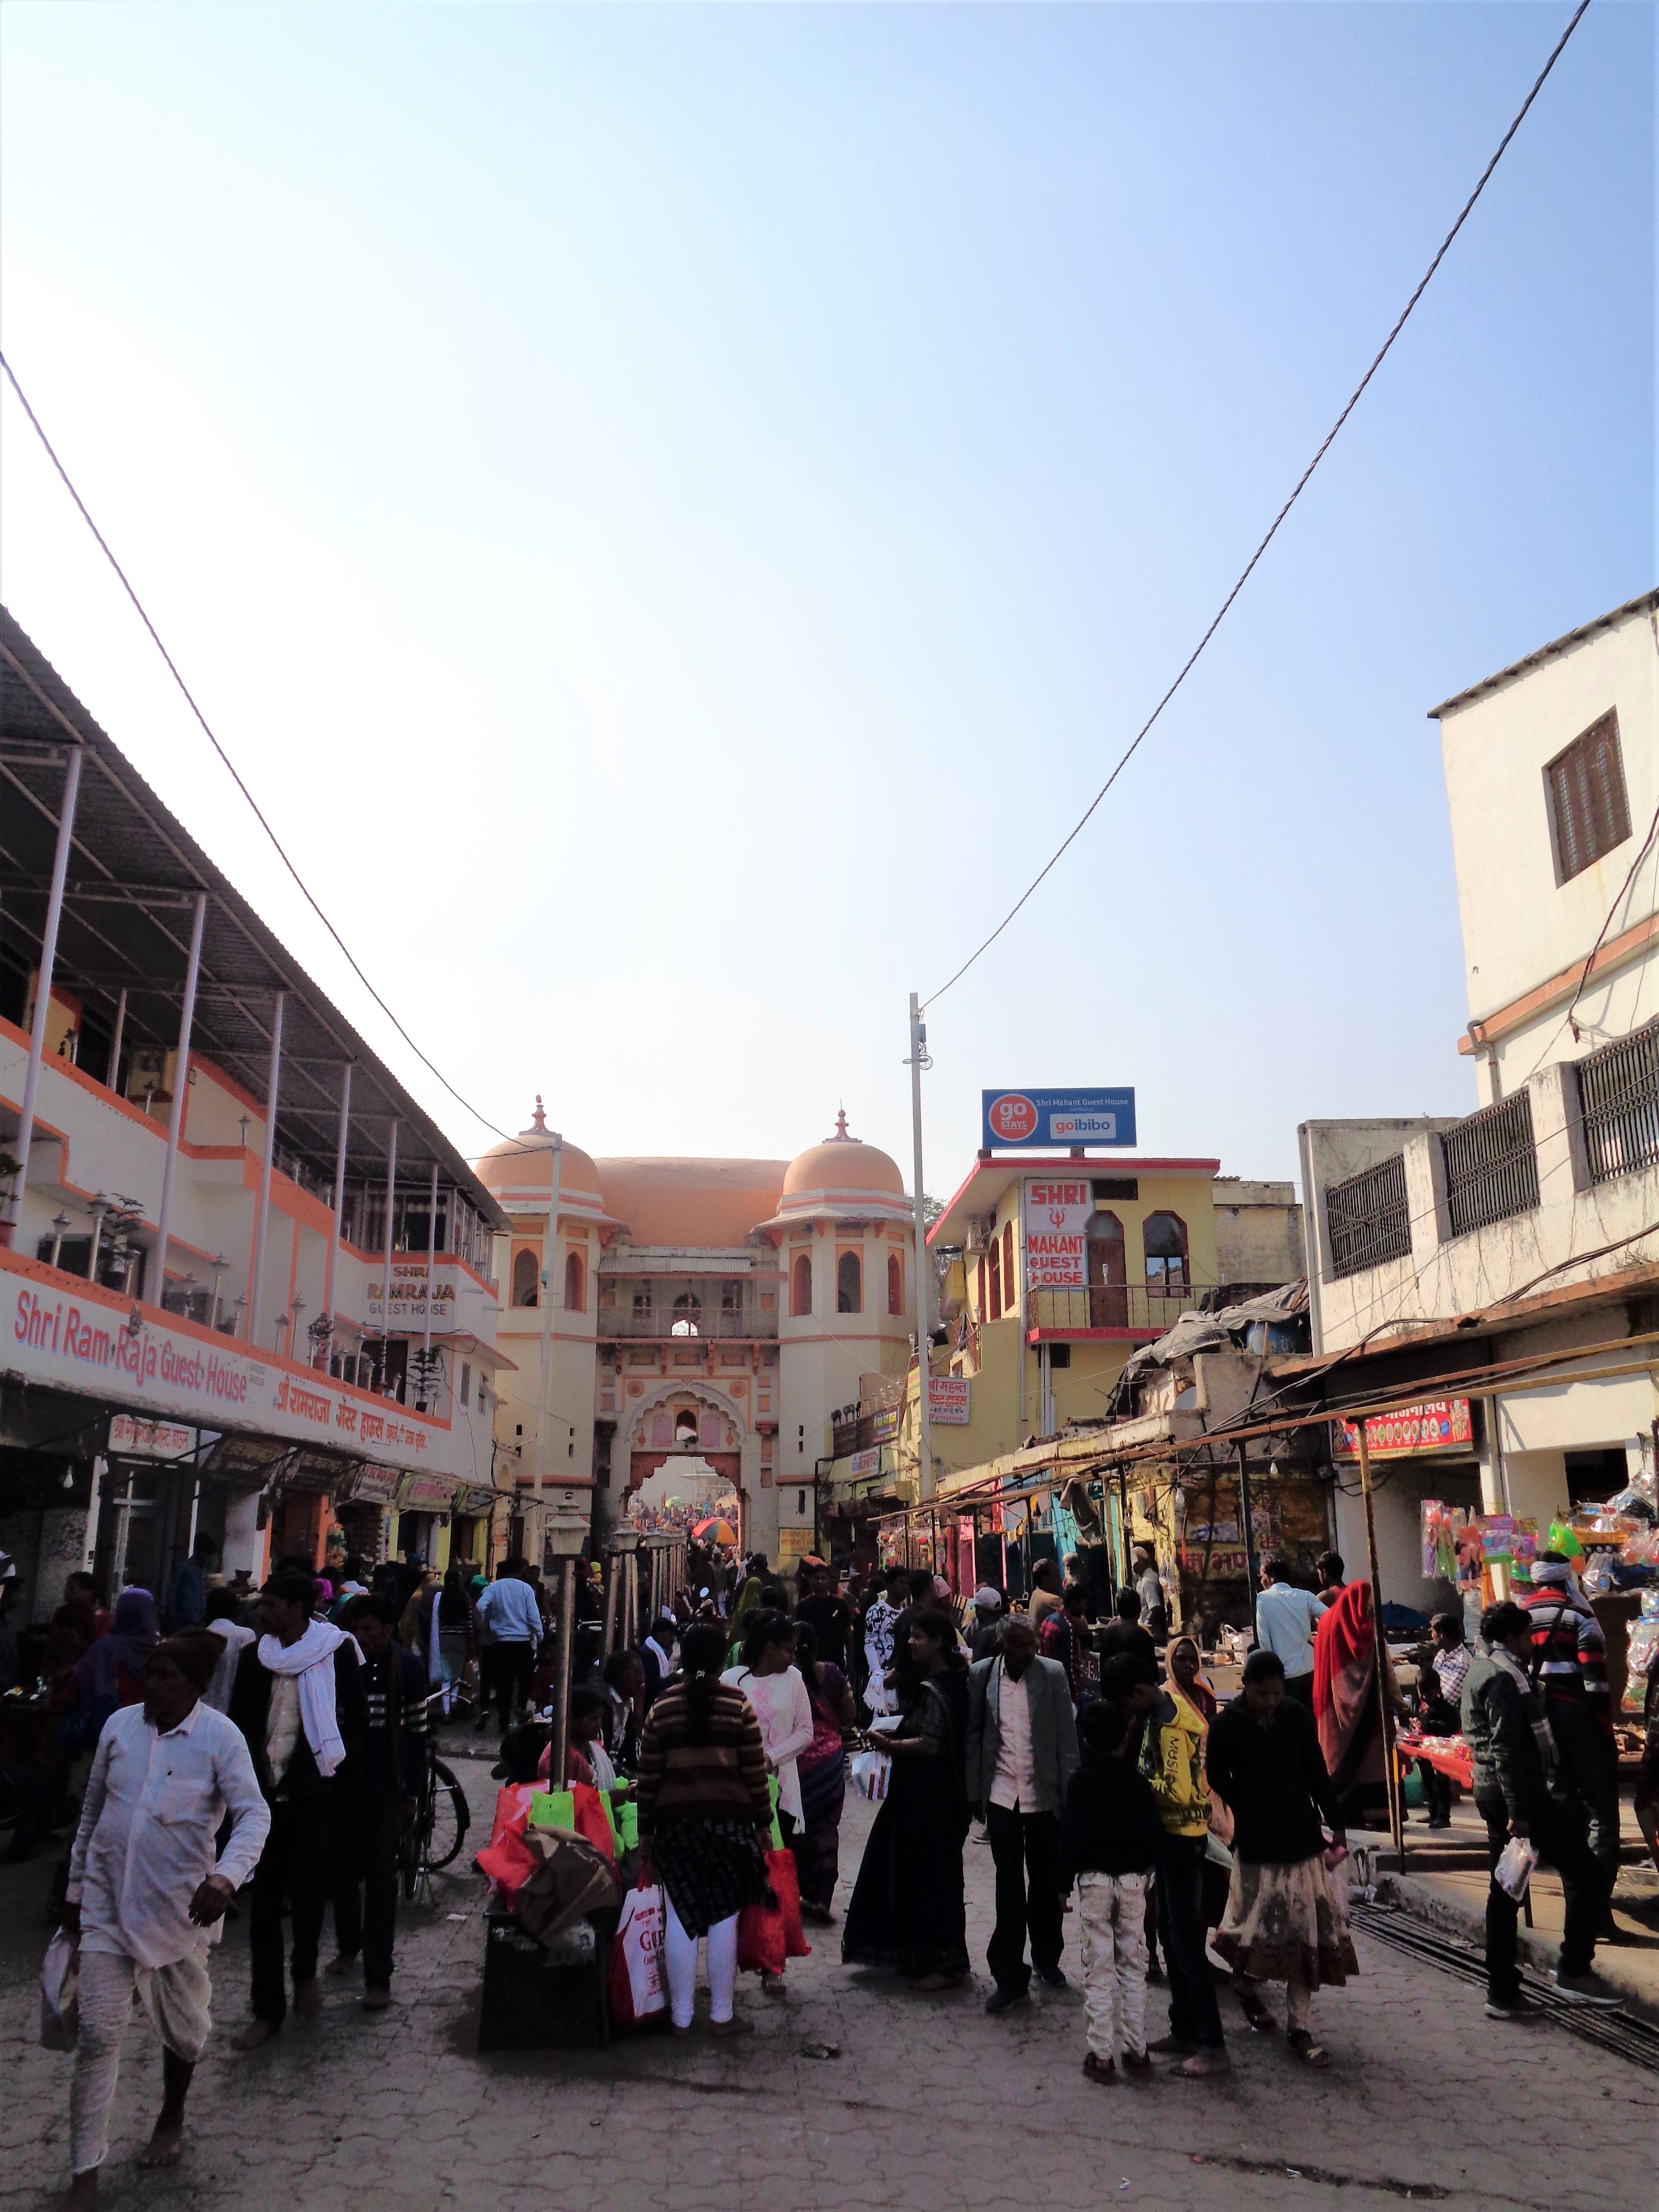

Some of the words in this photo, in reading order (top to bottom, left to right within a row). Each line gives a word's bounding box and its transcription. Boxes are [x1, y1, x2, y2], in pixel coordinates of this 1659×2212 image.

[1000, 1103, 1027, 1121] go
[1055, 1118, 1110, 1134] goibibo
[1030, 1184, 1086, 1205] SHRI
[1028, 1235, 1085, 1254] MAHANT
[1030, 1256, 1082, 1269] GUEST
[1031, 1272, 1083, 1284] HOUSE
[367, 1283, 456, 1301] RAMRAJA
[369, 1303, 408, 1315] GUEST
[14, 1290, 61, 1353] Shri
[63, 1306, 110, 1366] Ram
[115, 1323, 157, 1387] Raja
[160, 1340, 201, 1391] Guest
[205, 1353, 247, 1403] House
[940, 1381, 968, 1393] महन्त
